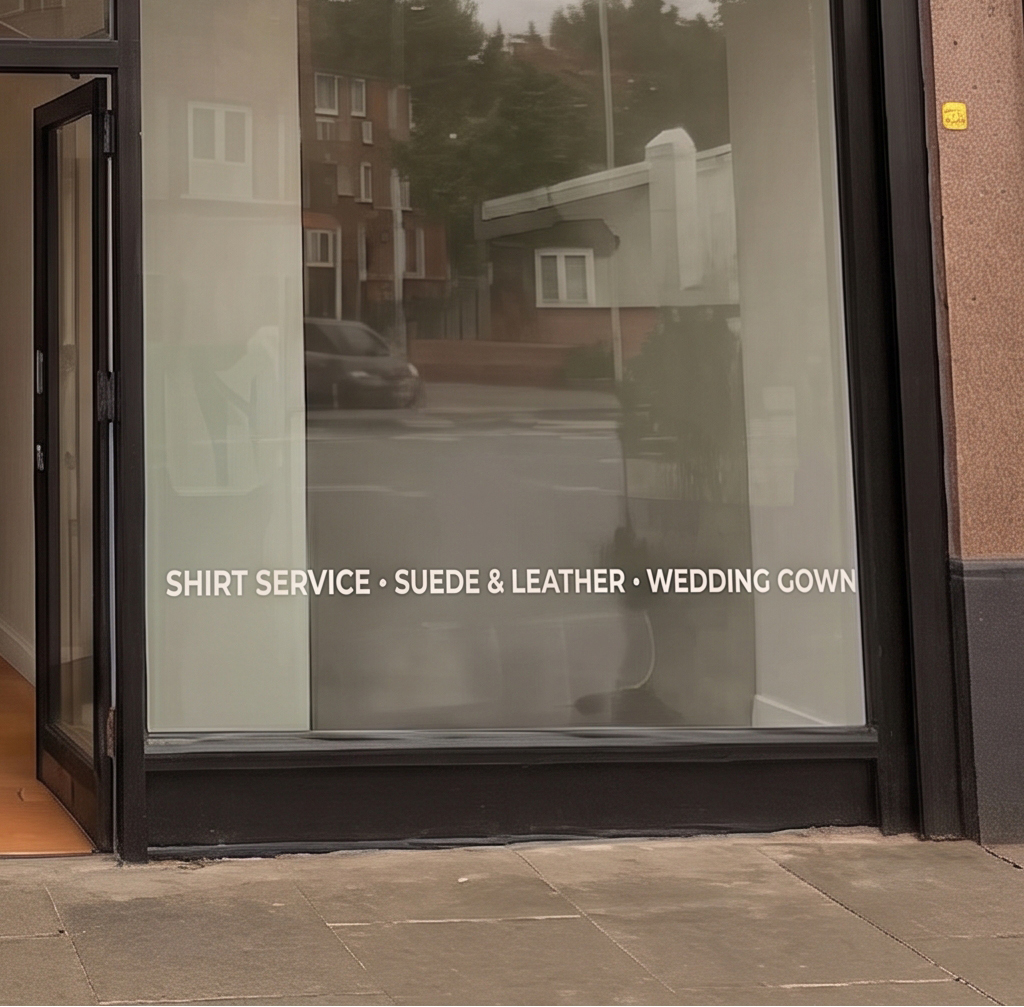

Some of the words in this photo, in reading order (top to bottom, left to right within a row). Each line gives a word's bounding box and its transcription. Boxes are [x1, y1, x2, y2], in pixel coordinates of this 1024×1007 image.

[165, 569, 249, 597] SHIRT
[255, 568, 371, 596] SERVICE
[394, 568, 481, 595] SUEDE
[486, 568, 505, 594] &
[511, 568, 626, 594] LEATHER
[646, 568, 770, 593] WEDDING
[777, 568, 858, 593] GOWN
